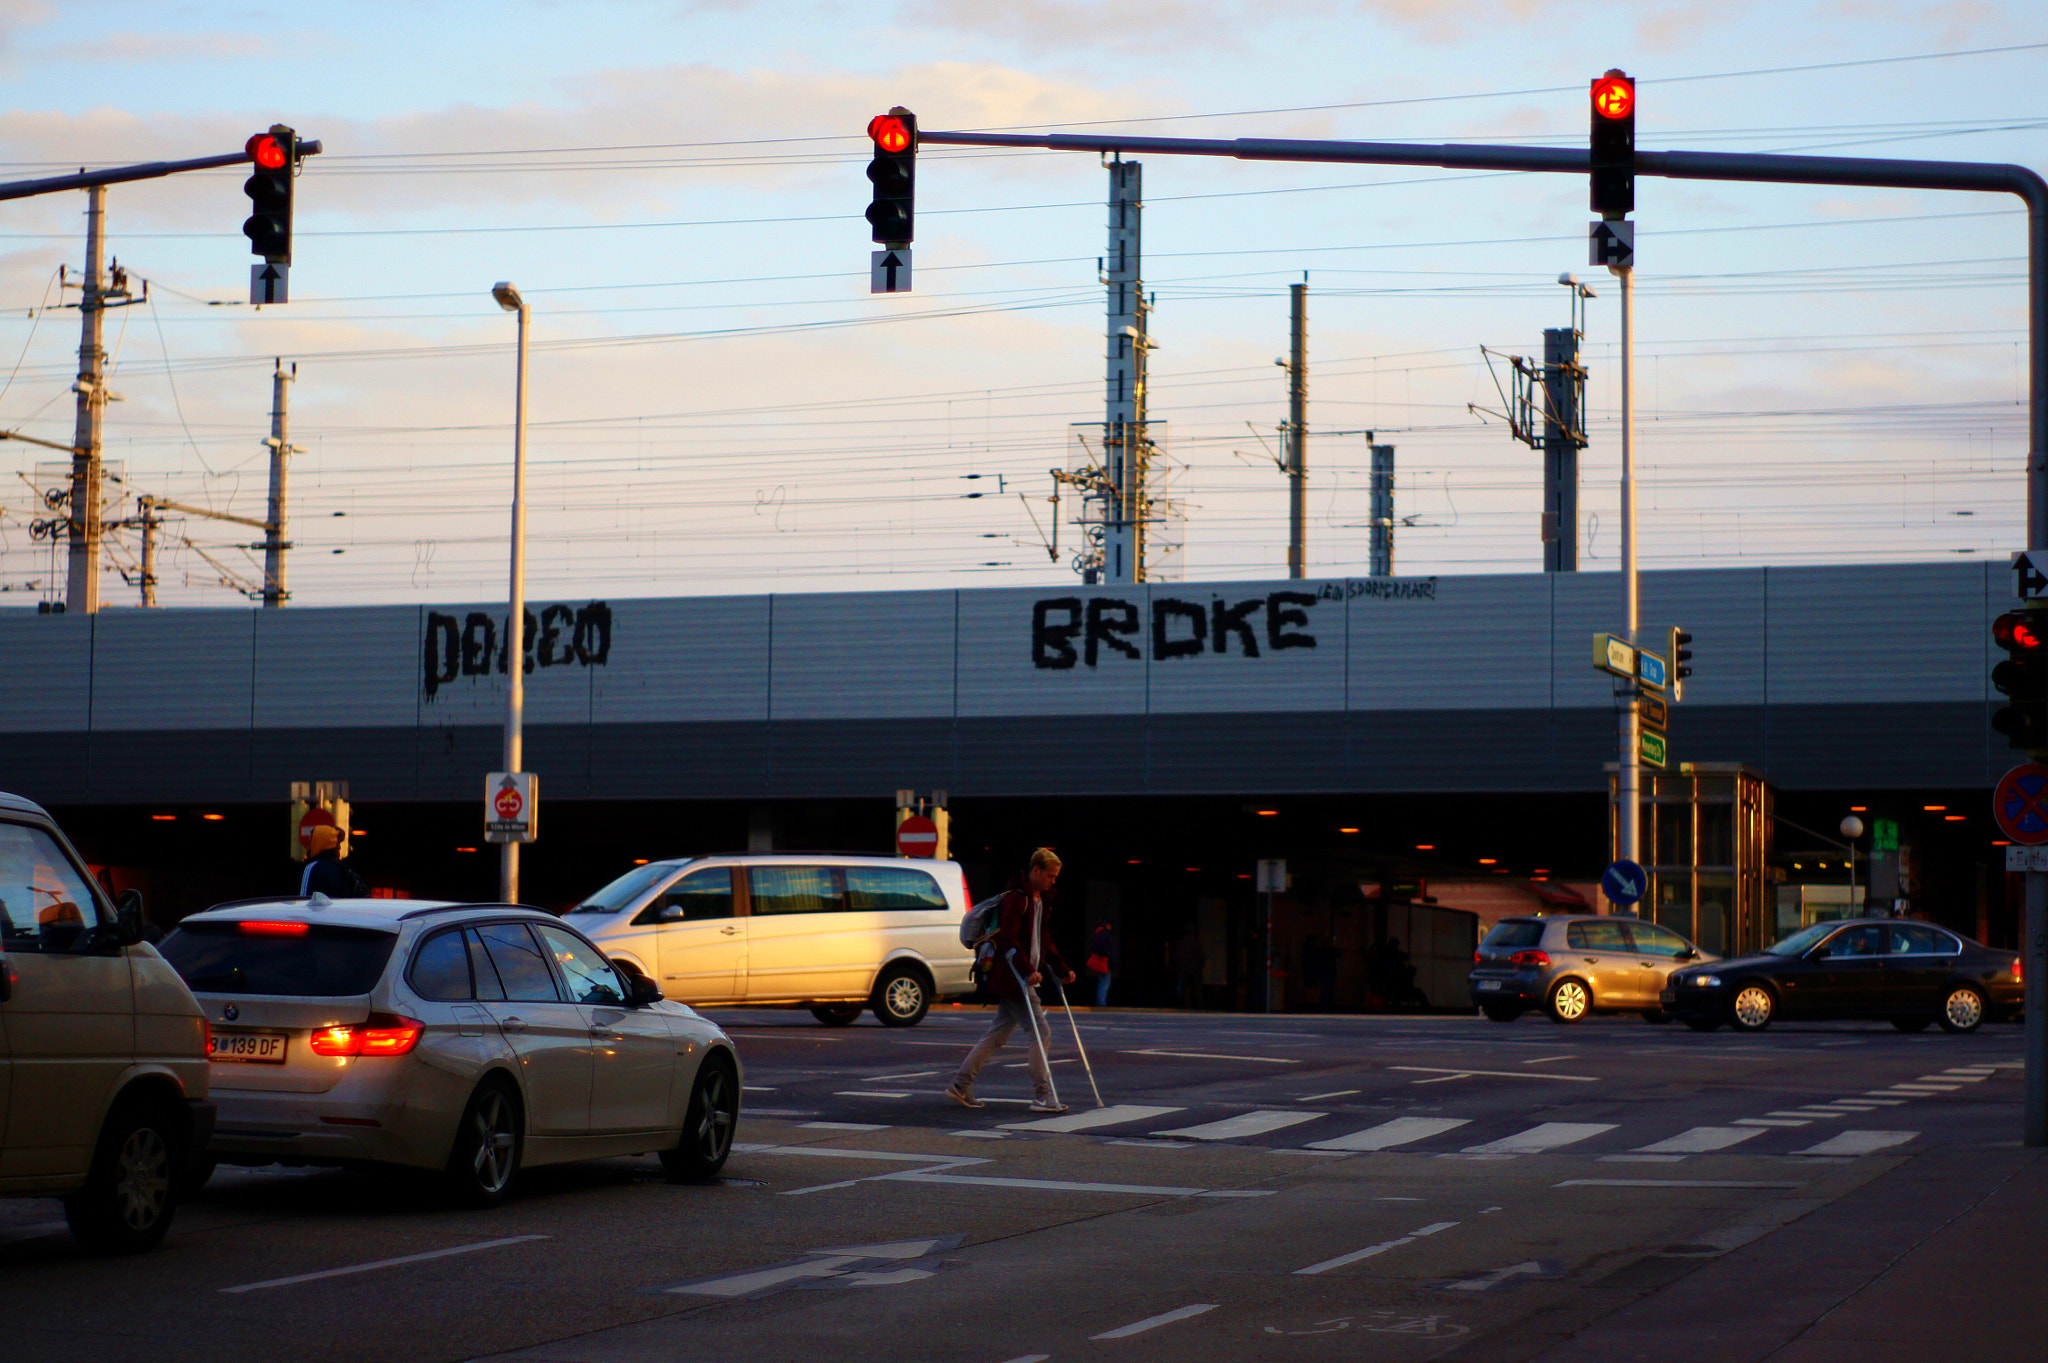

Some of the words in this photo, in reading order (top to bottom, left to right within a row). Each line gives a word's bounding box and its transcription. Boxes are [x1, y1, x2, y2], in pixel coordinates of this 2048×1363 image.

[1031, 590, 1318, 670] BROKE
[230, 1037, 257, 1055] 139
[259, 1038, 280, 1056] DF
